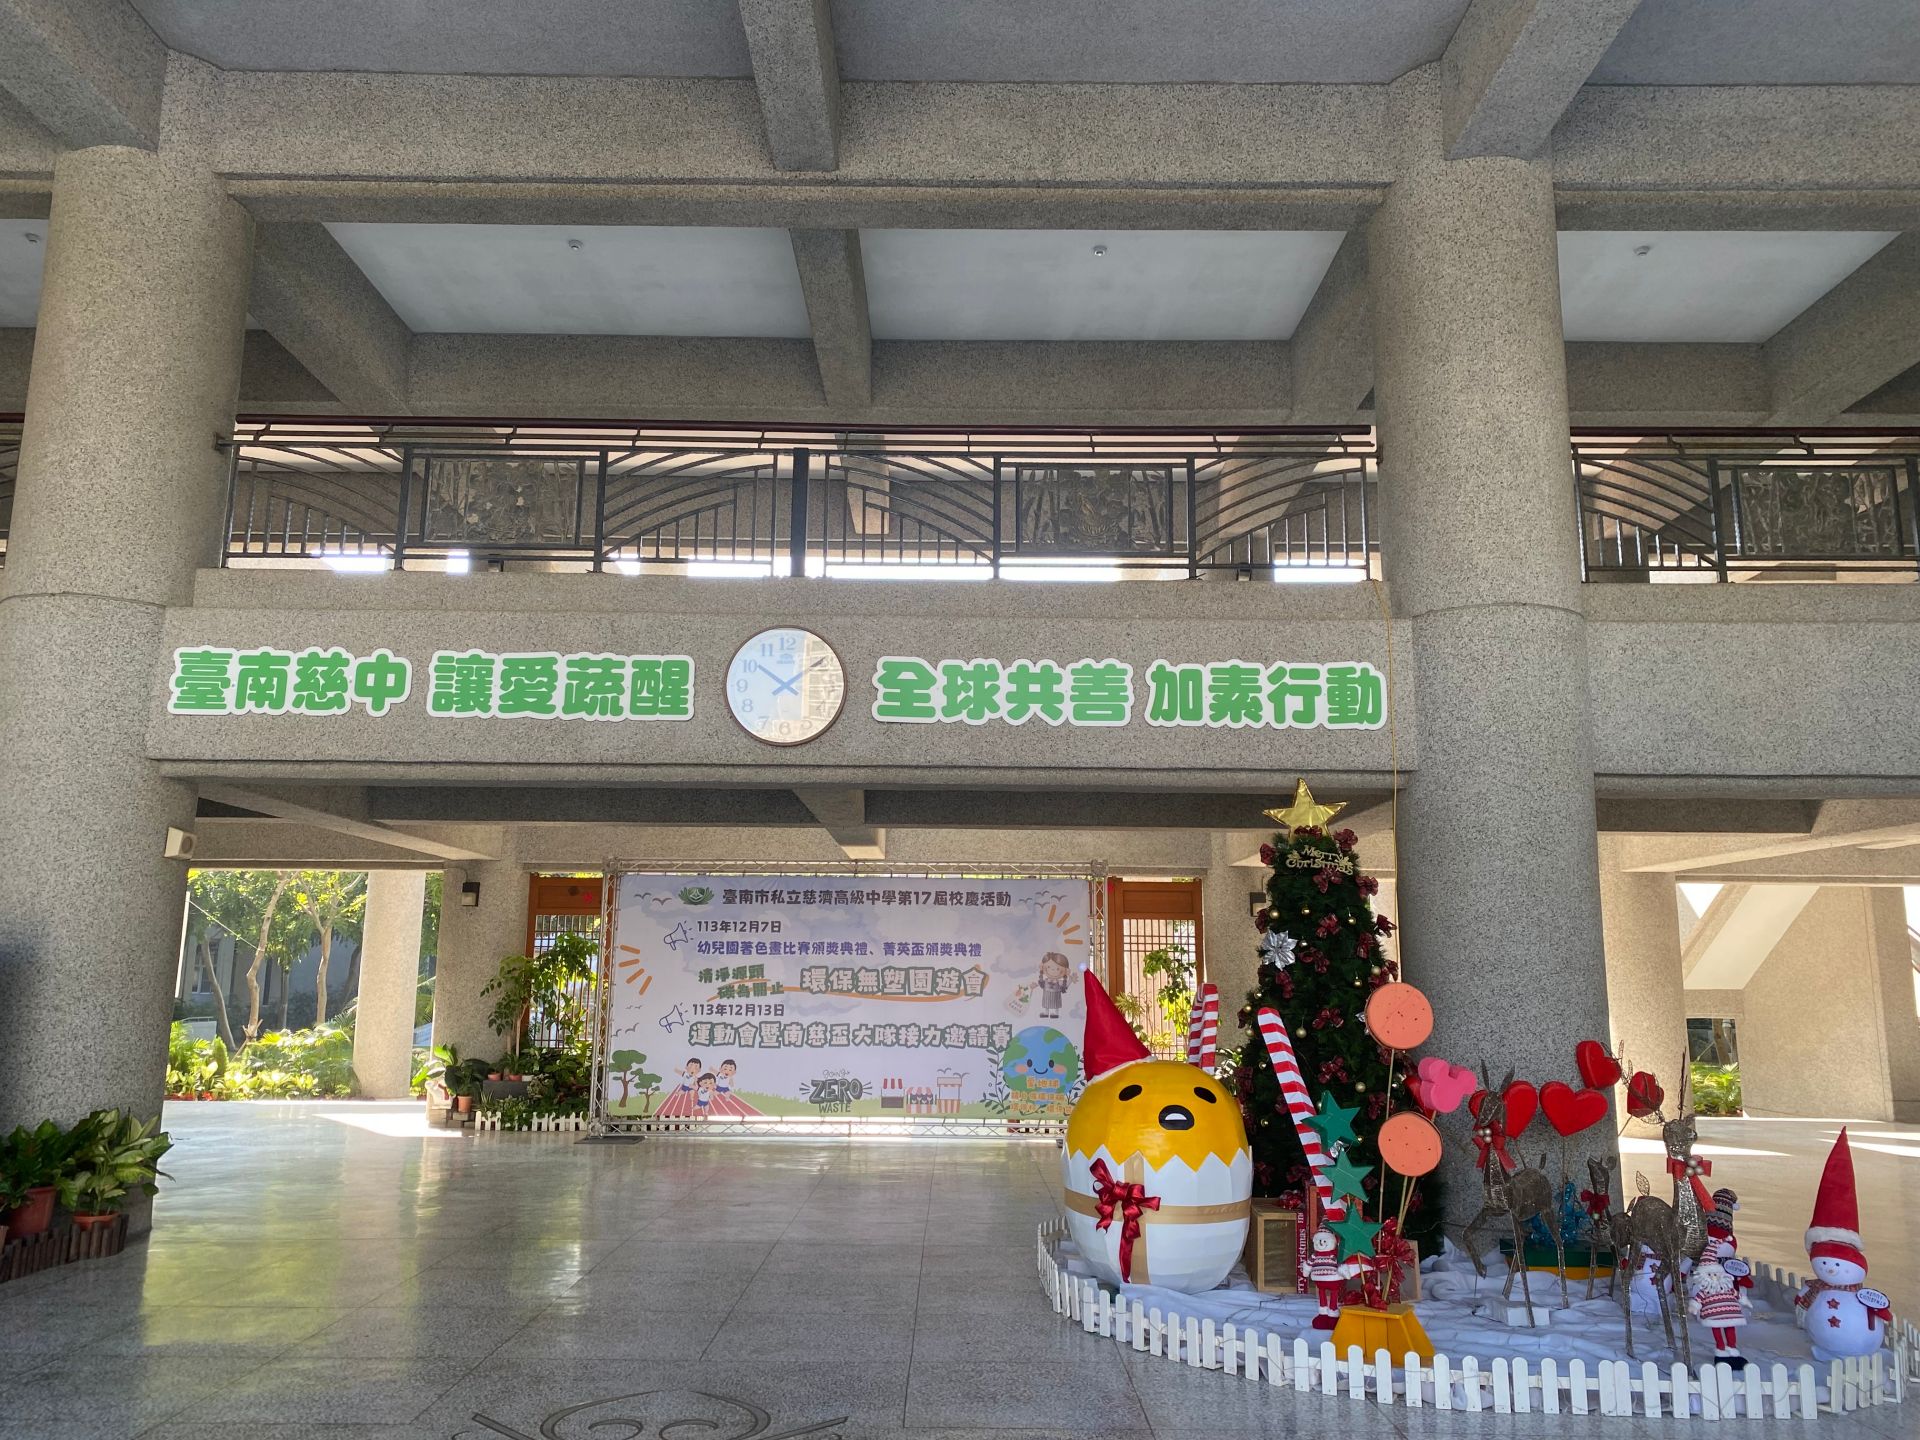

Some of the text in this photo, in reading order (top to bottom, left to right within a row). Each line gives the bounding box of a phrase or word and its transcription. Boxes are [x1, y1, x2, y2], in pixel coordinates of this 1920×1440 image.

[761, 643, 774, 657] 11
[779, 637, 796, 651] 12
[742, 659, 758, 673] 10
[171, 648, 1384, 726] 臺南慈中 讓愛蔬醒 全球共善 加素行動
[736, 679, 748, 693] 9
[741, 698, 754, 713] 8
[758, 716, 770, 730] 7
[778, 721, 791, 736] 6
[1302, 844, 1348, 863] Merry
[1285, 857, 1354, 876] Christmas
[722, 888, 1012, 907] 臺南市私立慈濟高級中學第17屆校慶活動
[697, 920, 782, 934] 113年12月7日
[800, 965, 988, 997] 環保無塑園遊會
[692, 1003, 785, 1017] 113年12月13日
[688, 1020, 1013, 1050] 運動會暨南慈盃大隊接力邀請賽
[808, 1078, 863, 1104] ZERO
[818, 1102, 851, 1113] WASTE
